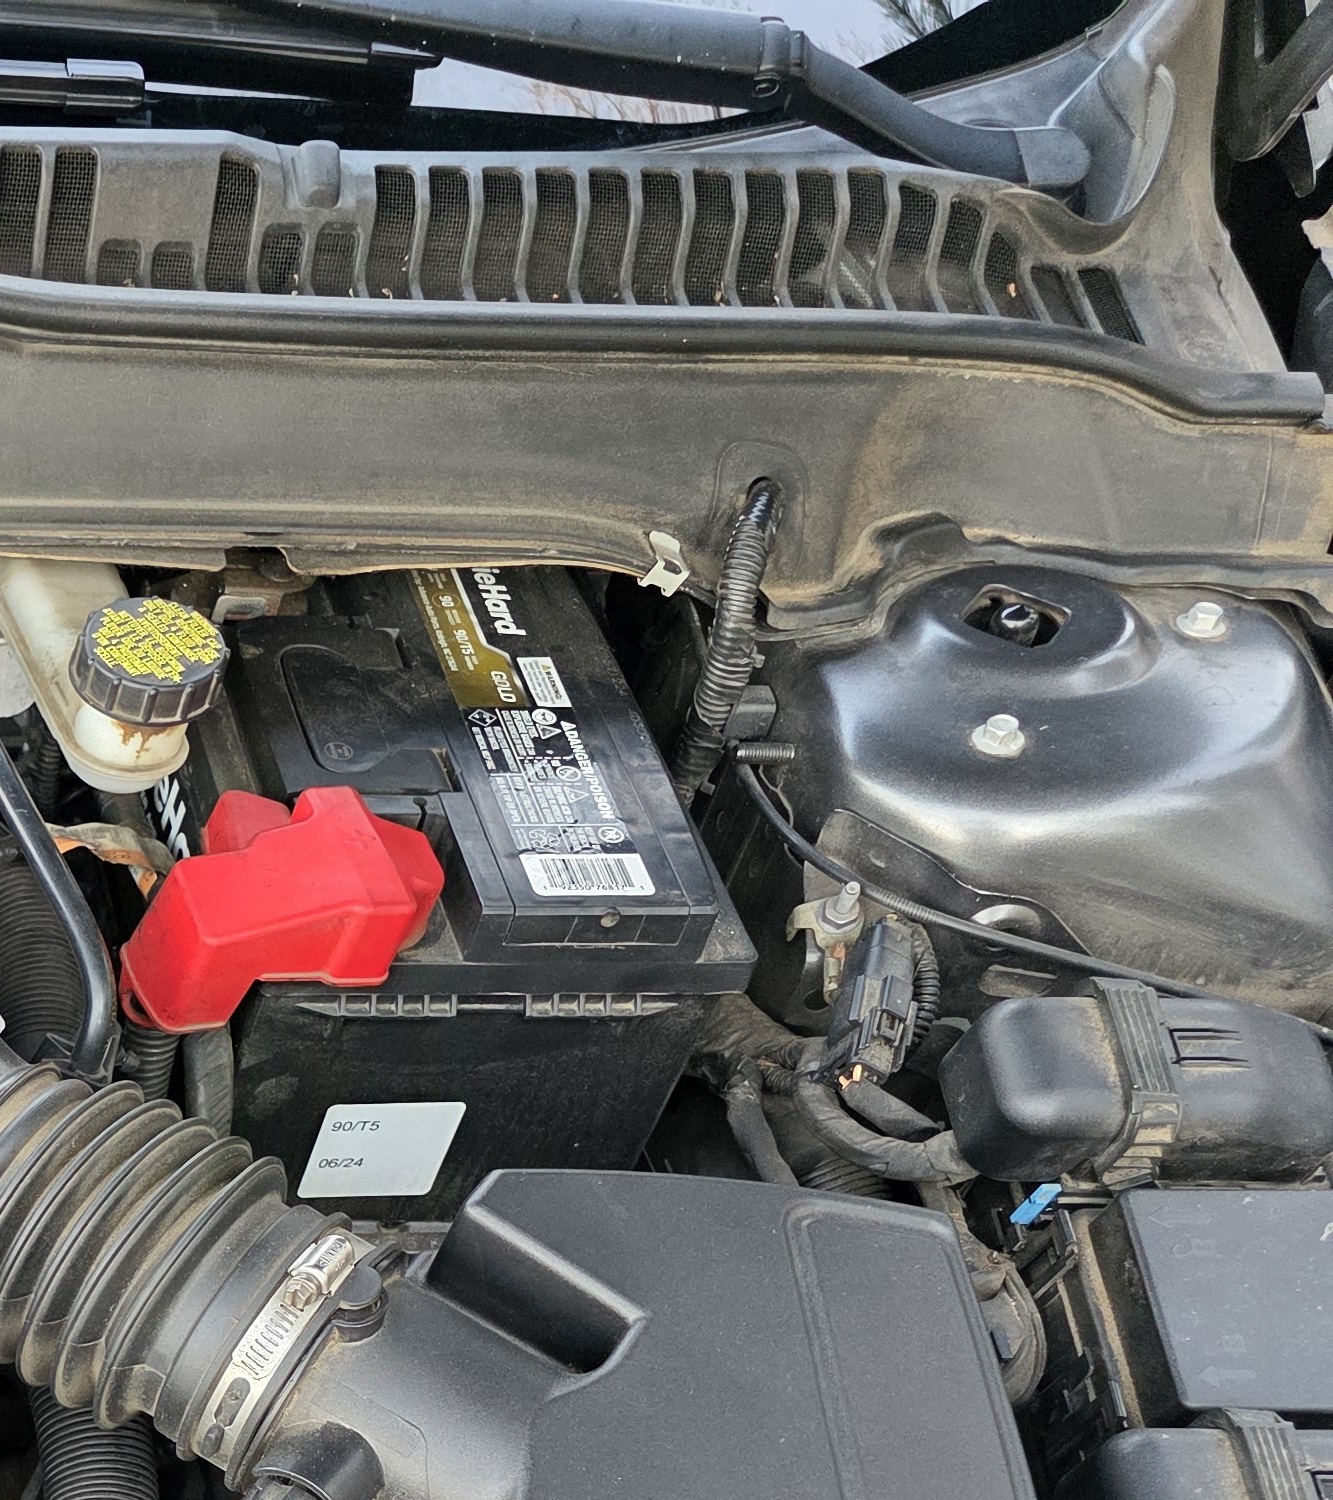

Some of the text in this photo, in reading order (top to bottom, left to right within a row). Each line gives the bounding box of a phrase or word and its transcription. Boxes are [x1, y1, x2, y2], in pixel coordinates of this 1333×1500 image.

[470, 567, 528, 636] ieHard
[490, 670, 517, 704] GOLD
[331, 1120, 381, 1132] 90/T5
[318, 1157, 364, 1168] 06/24
